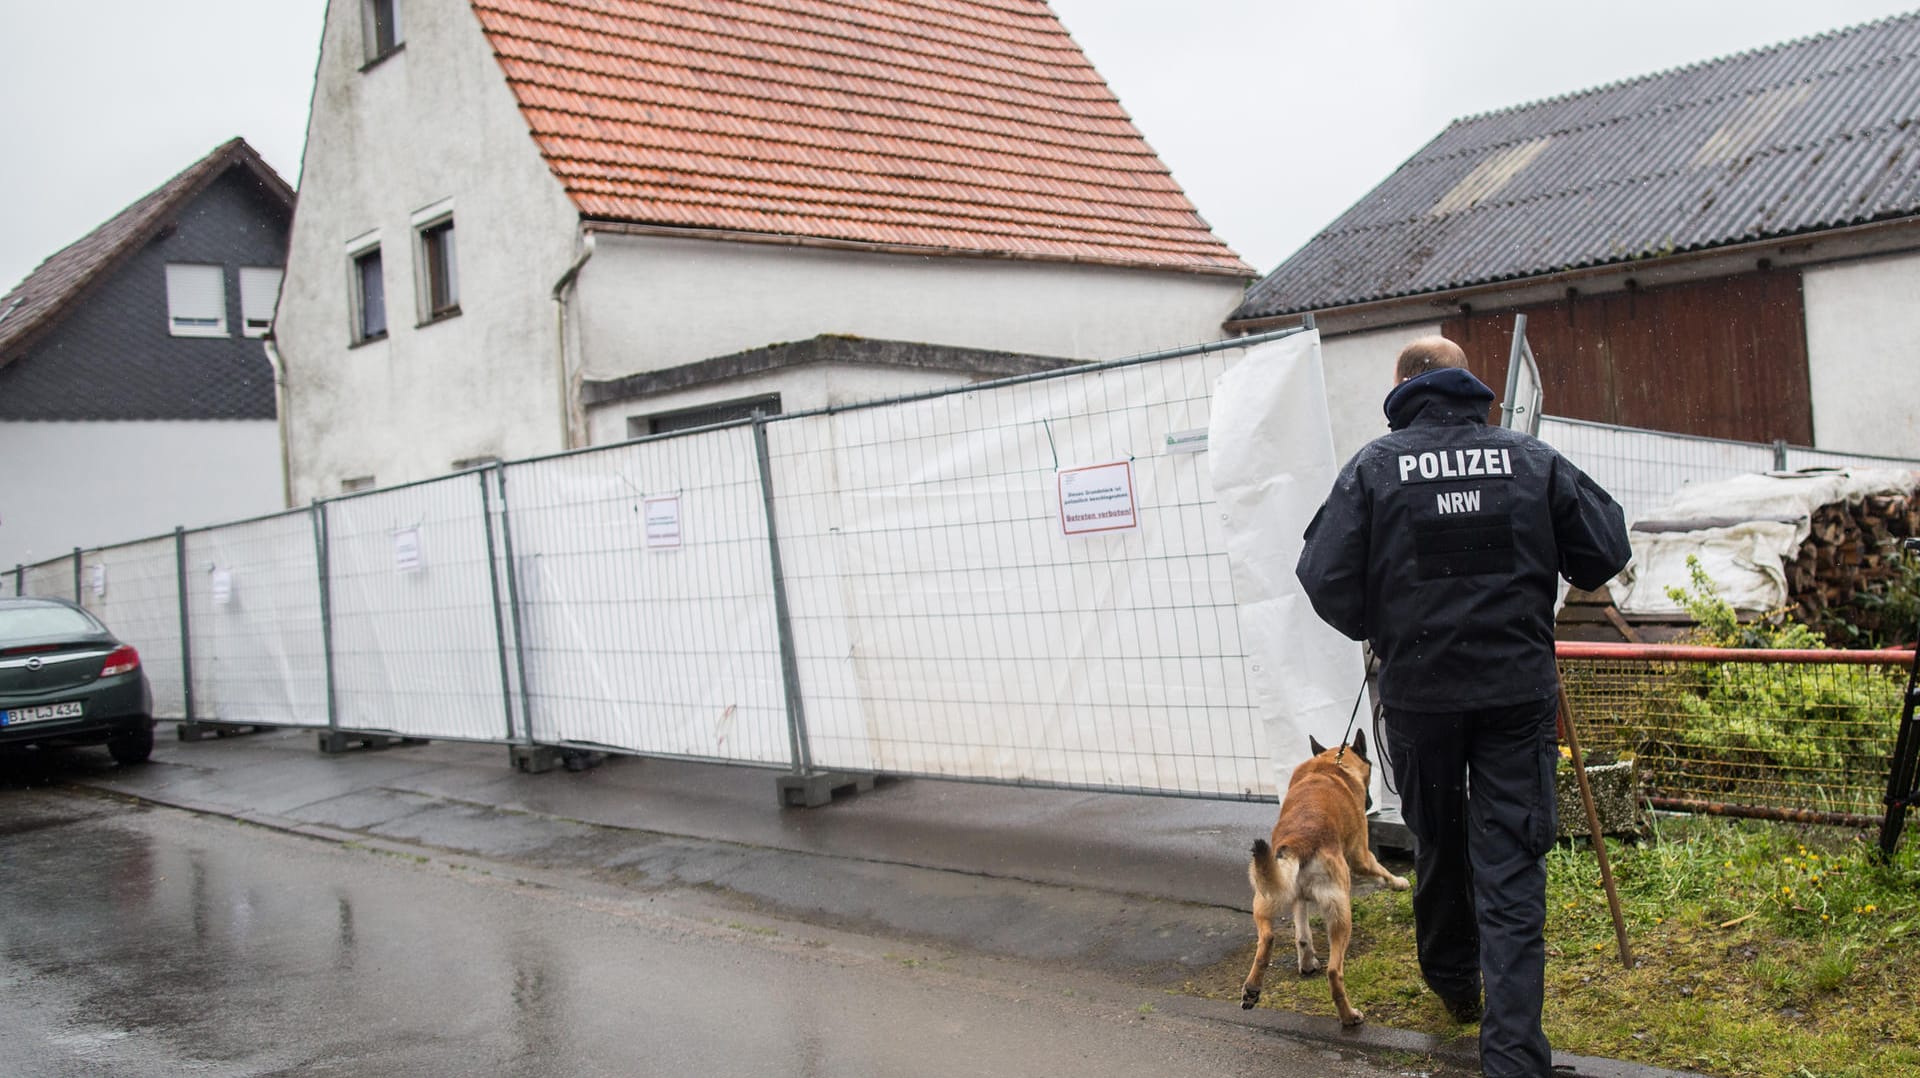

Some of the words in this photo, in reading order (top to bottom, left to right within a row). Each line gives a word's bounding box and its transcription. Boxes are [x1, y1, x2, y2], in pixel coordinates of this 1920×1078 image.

[1398, 448, 1512, 482] POLIZEI
[1437, 490, 1480, 514] NRW
[9, 710, 26, 722] BI
[36, 706, 54, 719] LJ
[56, 703, 80, 716] 434
